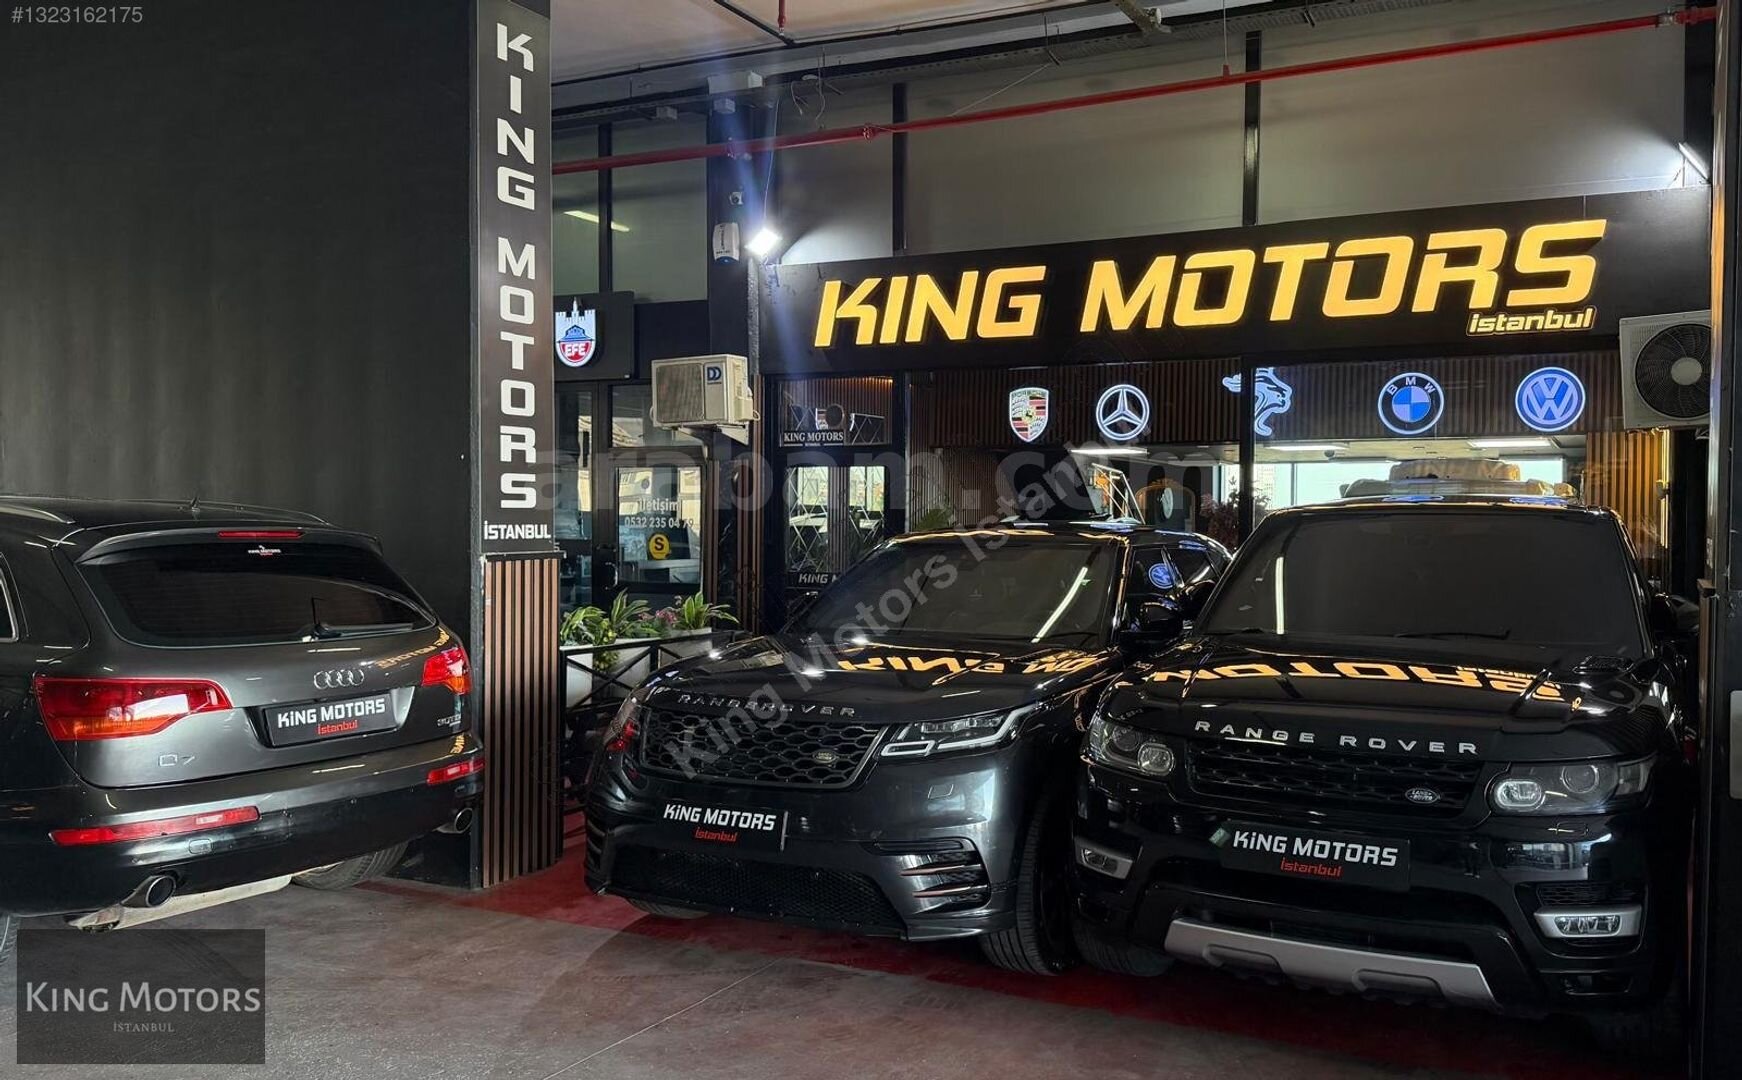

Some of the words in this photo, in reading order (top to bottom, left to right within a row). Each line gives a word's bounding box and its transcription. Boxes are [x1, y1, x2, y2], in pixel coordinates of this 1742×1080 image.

[497, 23, 535, 211] KING
[814, 264, 1047, 348] KING
[1080, 219, 1607, 332] MOTORS
[1469, 308, 1593, 333] istanbul
[564, 343, 588, 357] EFE
[498, 236, 537, 509] MOTORS
[1387, 376, 1436, 395] BMW
[783, 432, 806, 442] KING
[807, 431, 844, 441] MOTORS
[484, 520, 552, 540] İSTANBUL
[649, 516, 667, 528] 235
[668, 517, 680, 528] 04
[799, 573, 828, 584] KING
[320, 698, 386, 722] MOTORS
[1194, 720, 1315, 744] RANGE
[1339, 734, 1478, 755] ROVER
[703, 807, 777, 831] MOTORS
[1292, 836, 1399, 867] MOTORS
